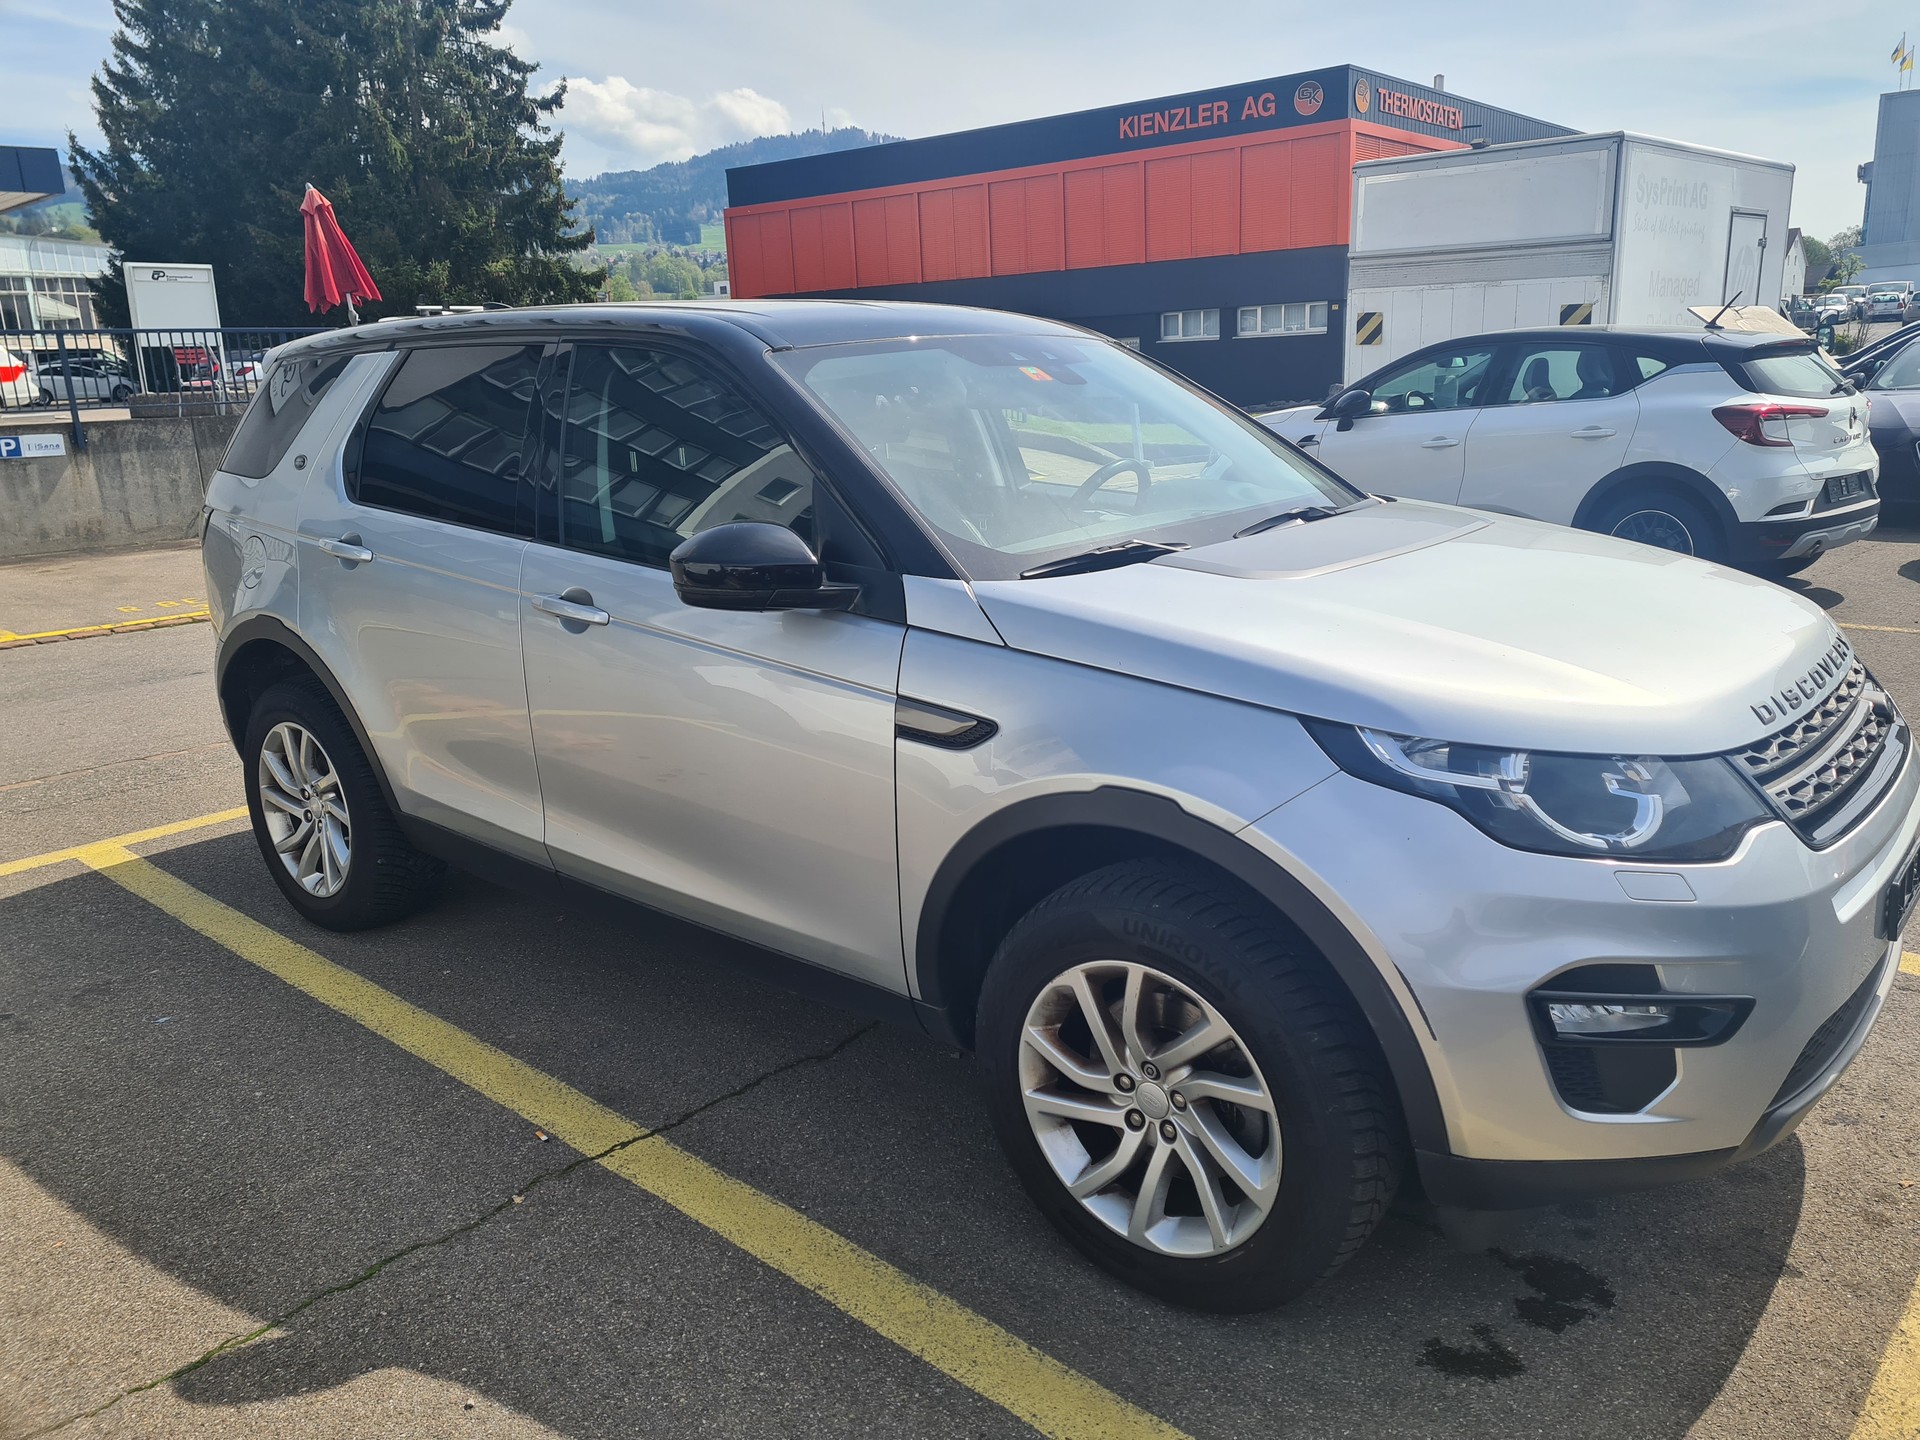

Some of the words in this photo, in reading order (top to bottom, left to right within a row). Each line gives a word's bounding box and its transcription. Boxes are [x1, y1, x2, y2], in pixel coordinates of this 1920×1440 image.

[1119, 101, 1229, 139] KIENZLER
[1241, 93, 1277, 120] AG
[1377, 88, 1463, 130] THERMOSTATEN
[1636, 172, 1688, 210] SysPrint
[1689, 182, 1708, 210] AG
[1649, 269, 1700, 303] Managed
[0, 438, 16, 457] P
[1749, 632, 1850, 726] DISCOVERY
